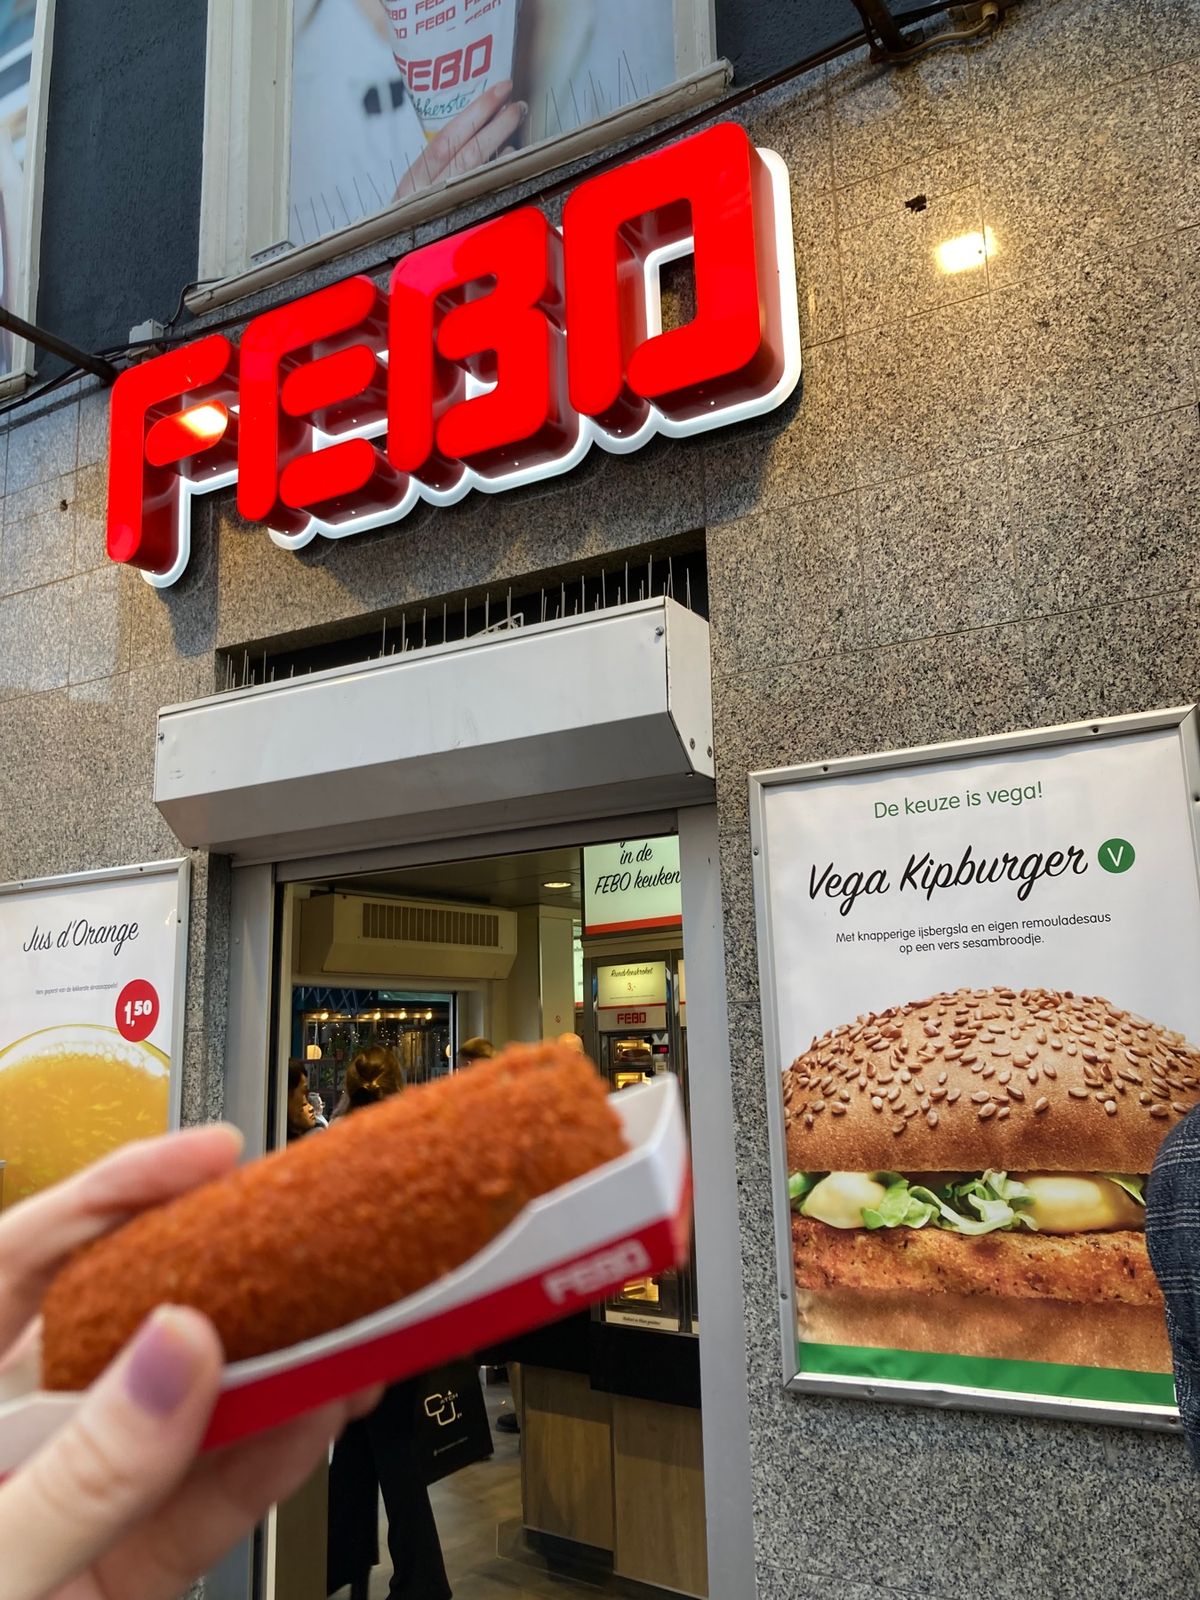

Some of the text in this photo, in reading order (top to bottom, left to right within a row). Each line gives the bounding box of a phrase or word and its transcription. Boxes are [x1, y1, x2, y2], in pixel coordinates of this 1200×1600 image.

[415, 6, 456, 35] FEBO
[107, 121, 762, 563] FEBO
[874, 781, 1043, 819] De keuze is vega!
[620, 850, 634, 865] in
[635, 843, 653, 863] de
[594, 866, 682, 895] FEBO keuken
[808, 844, 1125, 917] Vega Kipburger V
[23, 919, 139, 956] Jus d'Orange
[835, 912, 1112, 943] Met knapperige ijsbergsla en eigen remouladesaus
[899, 933, 1045, 955] op een vers sesambroodje.
[124, 999, 153, 1027] 1,50
[617, 1012, 647, 1025] FEBO
